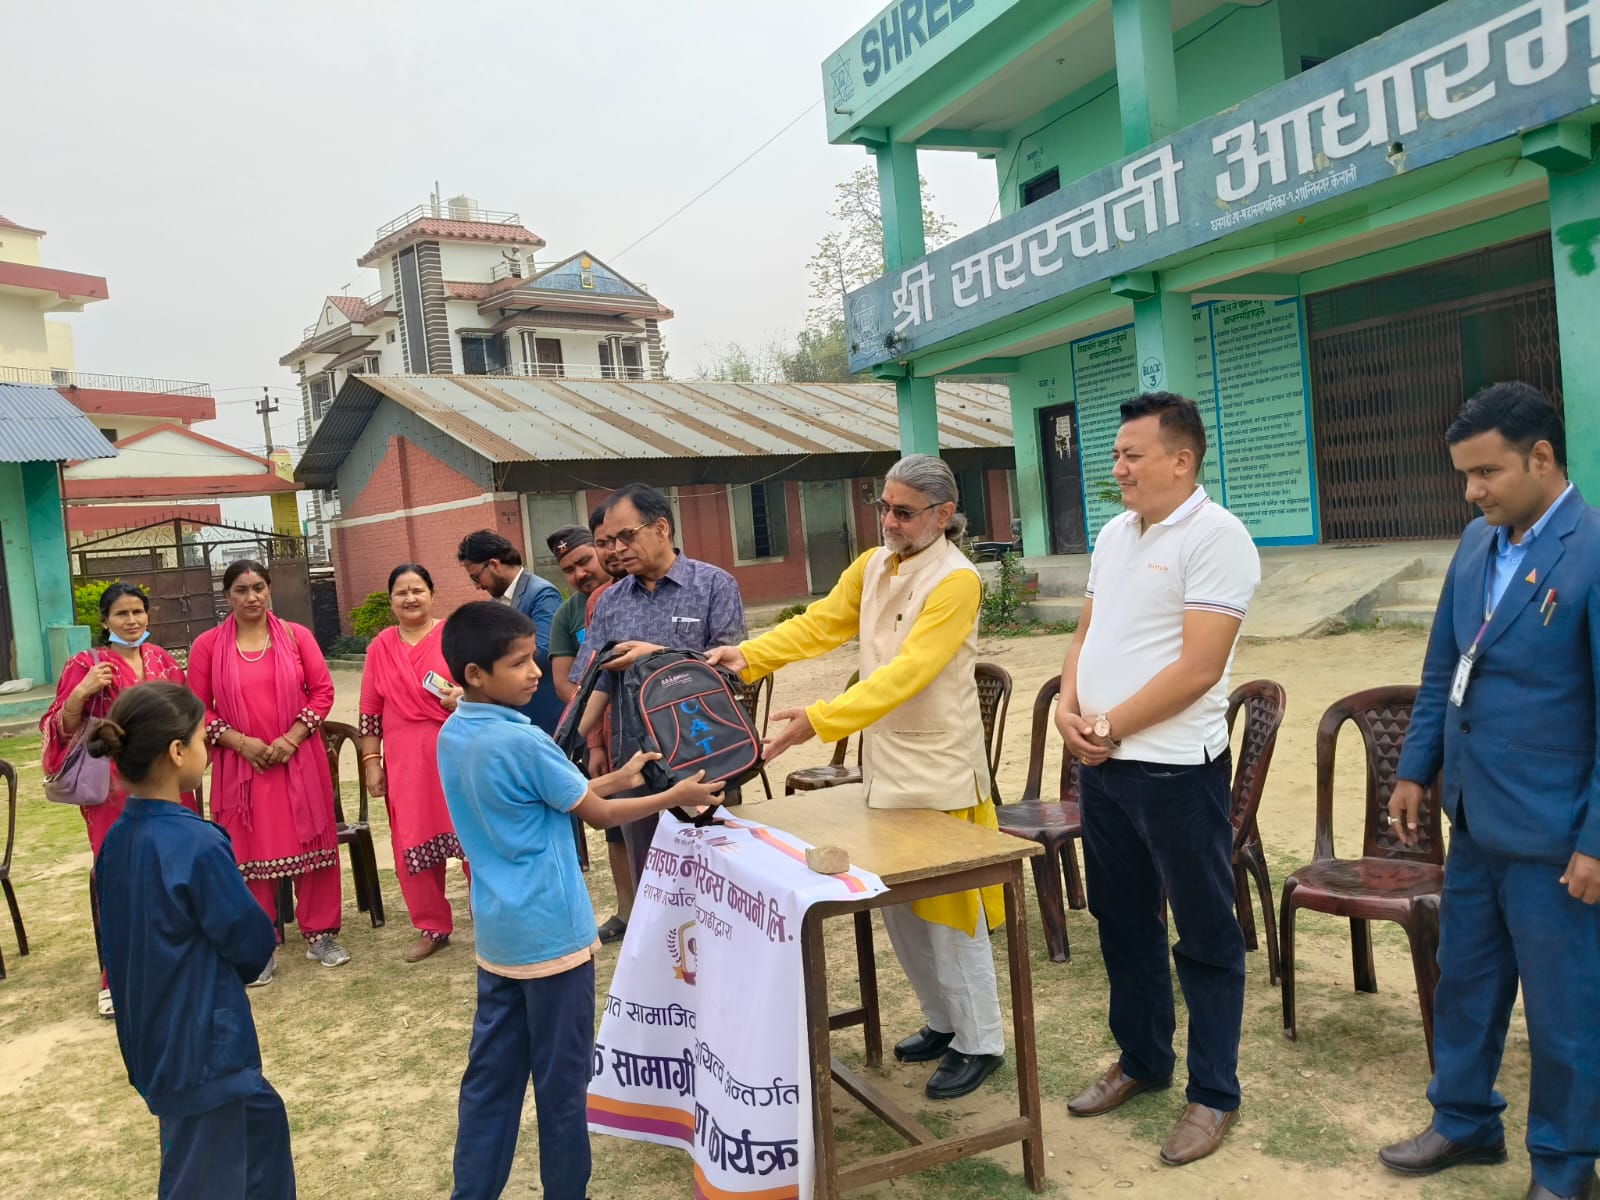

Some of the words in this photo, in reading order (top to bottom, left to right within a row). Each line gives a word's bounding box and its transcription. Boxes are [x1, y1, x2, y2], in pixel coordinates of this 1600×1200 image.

[892, 262, 936, 332] श्री
[951, 144, 1184, 308] सरस्वती
[1212, 0, 1600, 202] आधारभ
[1150, 375, 1157, 387] 3
[728, 880, 766, 931] कम्पनी
[709, 1116, 799, 1176] कार्यक्र
